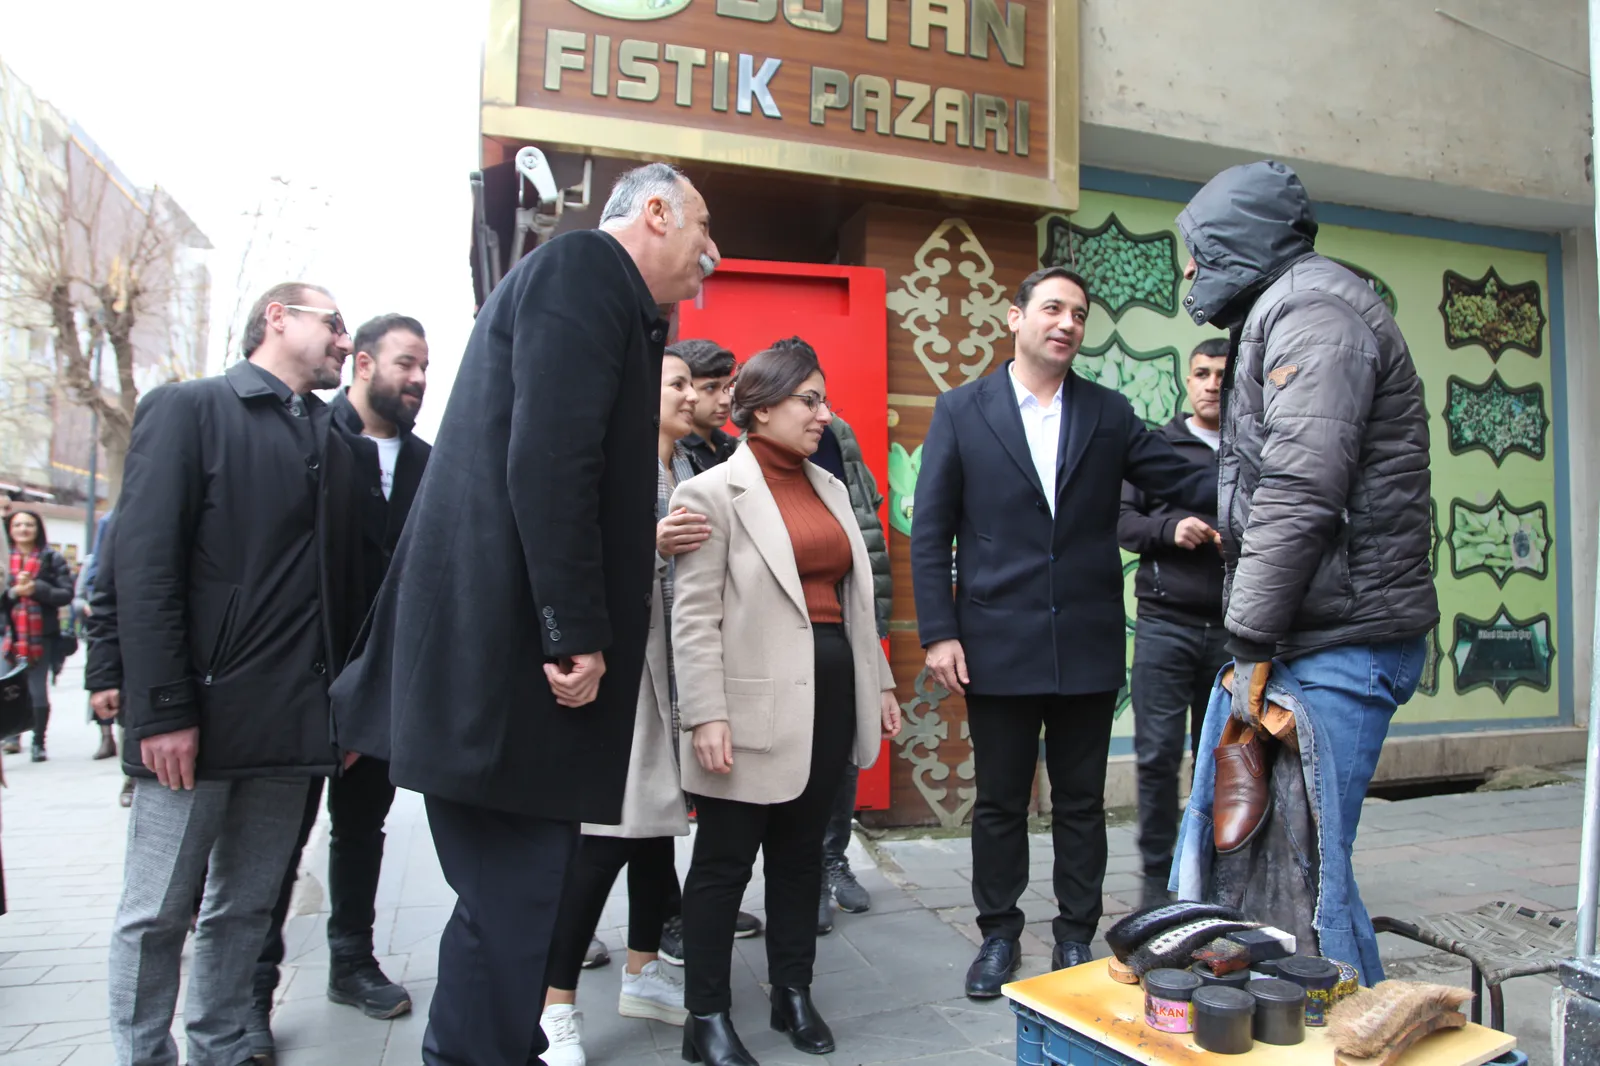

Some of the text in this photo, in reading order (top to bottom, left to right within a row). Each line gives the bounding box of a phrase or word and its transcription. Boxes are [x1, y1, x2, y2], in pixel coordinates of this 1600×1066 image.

[543, 28, 1030, 156] FISTIK PAZARI
[1151, 1004, 1185, 1018] LKAN
